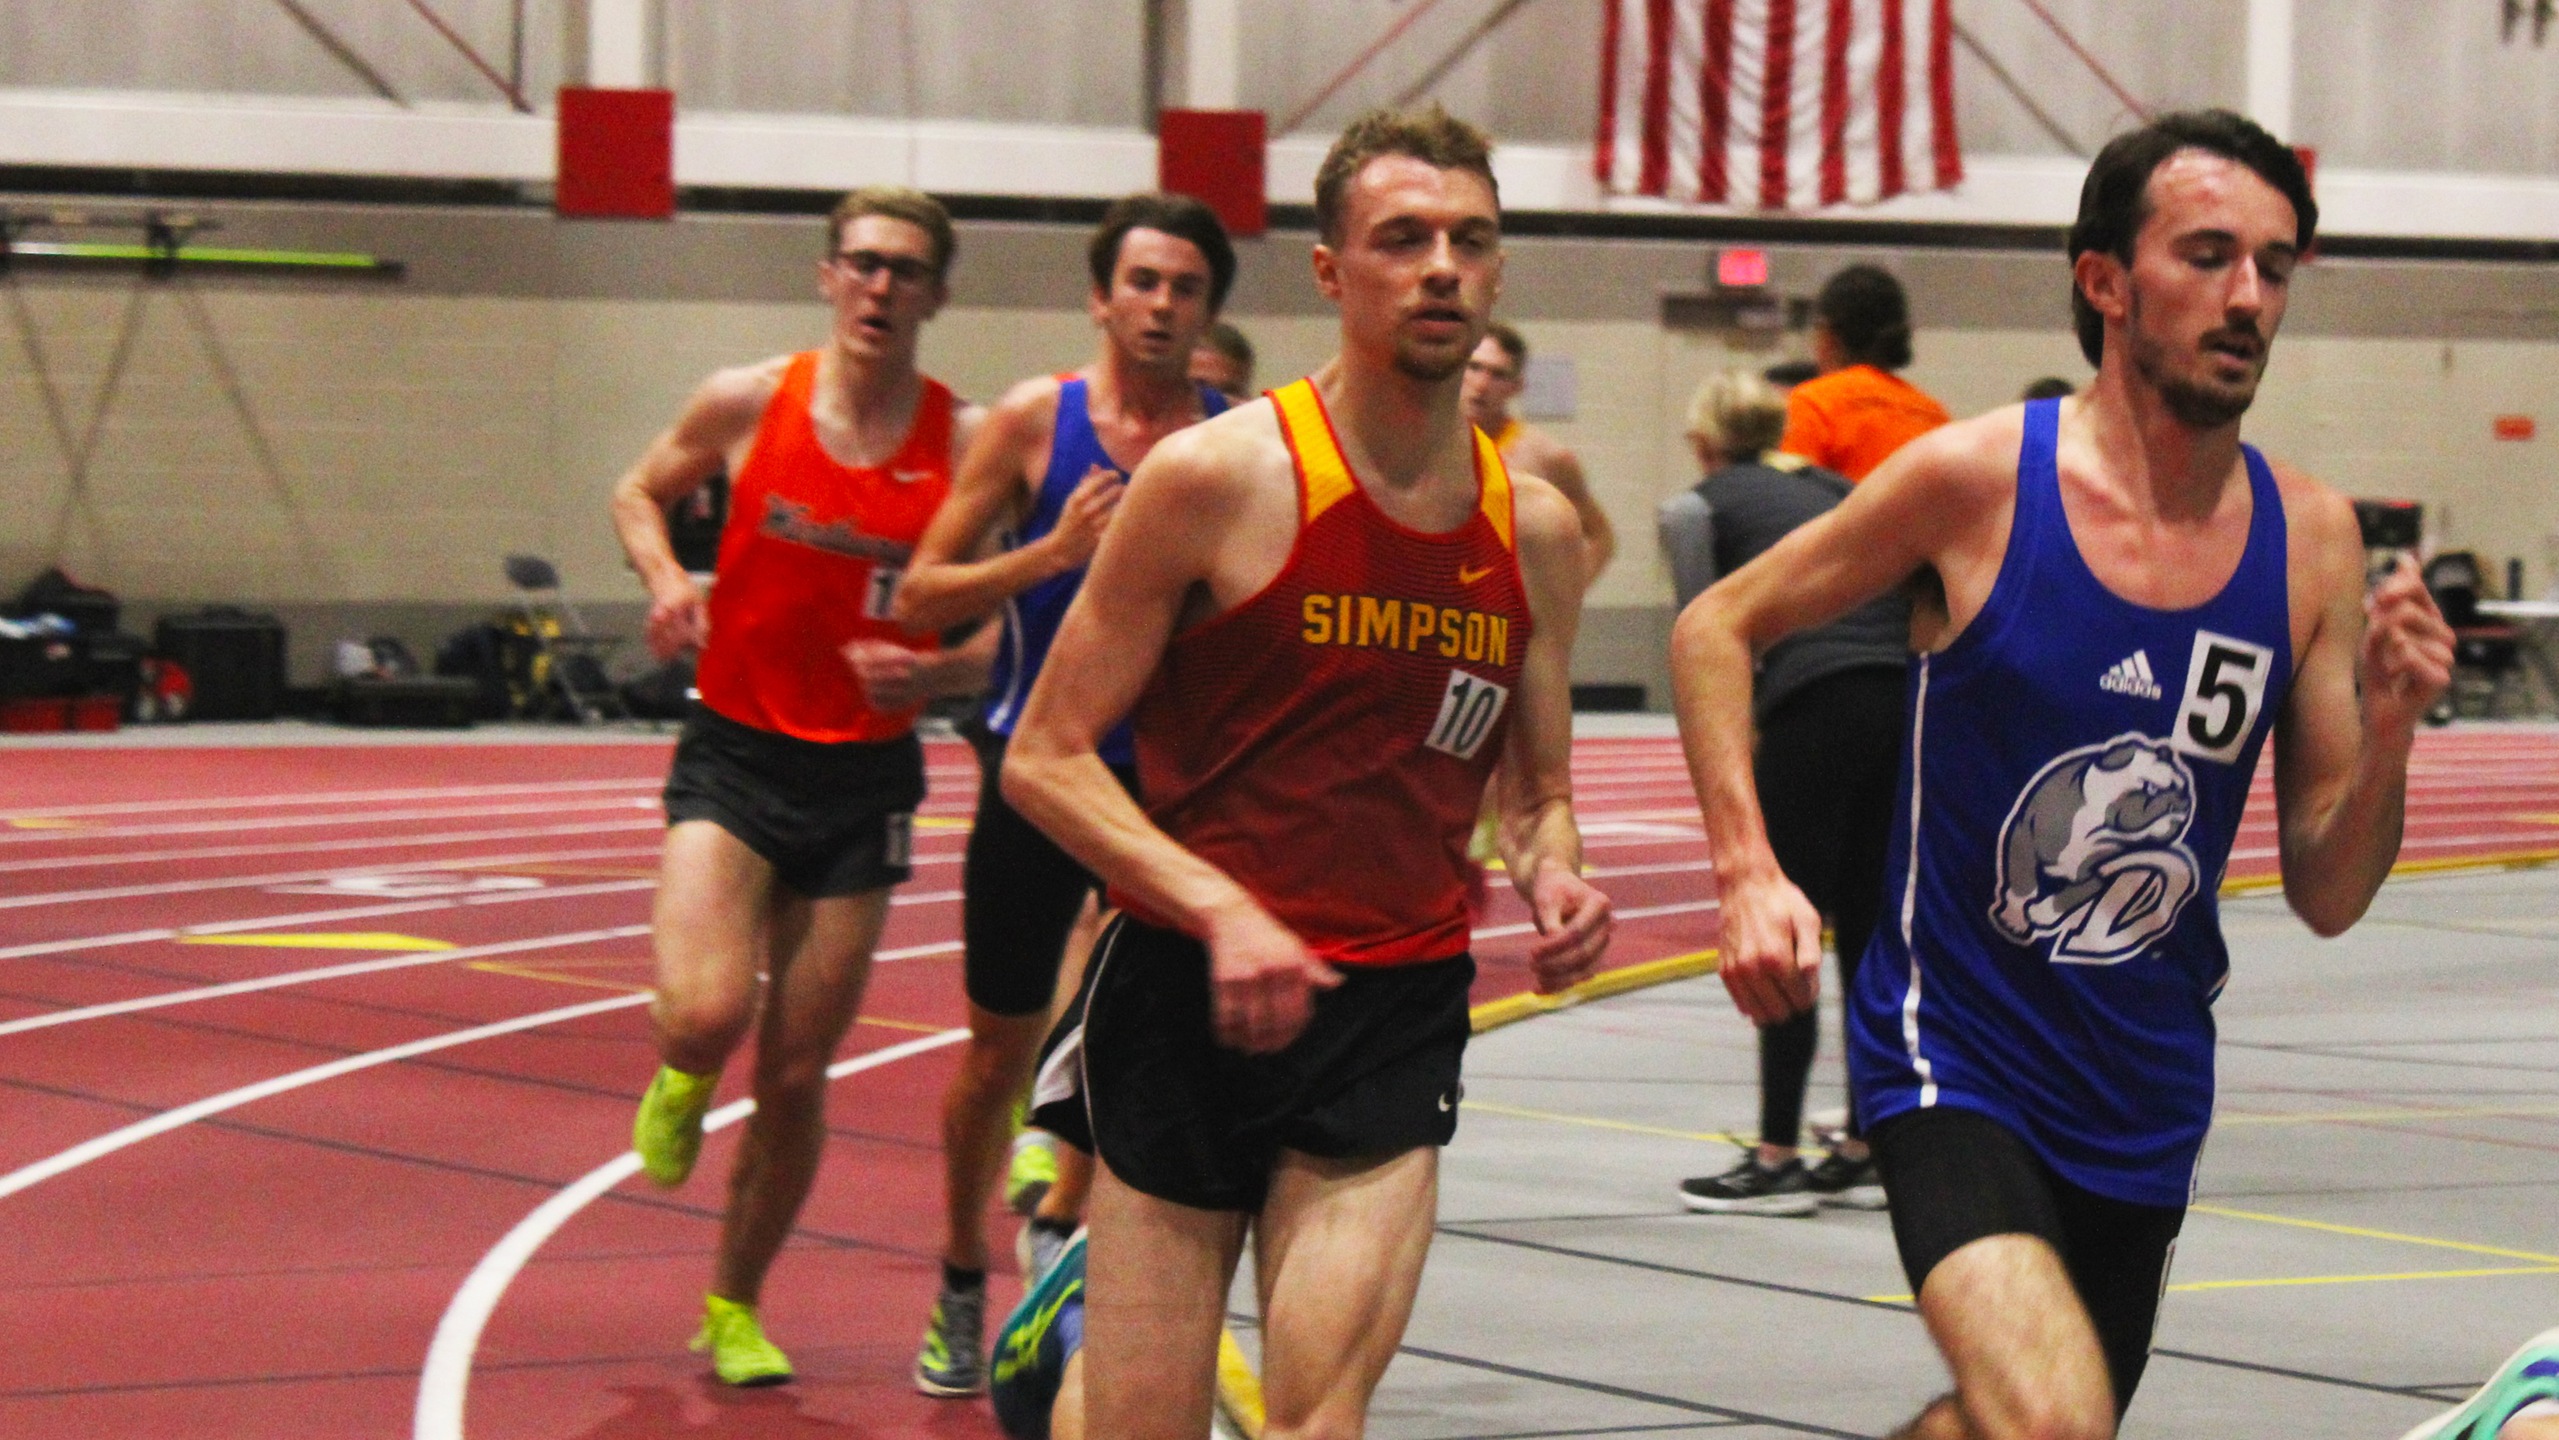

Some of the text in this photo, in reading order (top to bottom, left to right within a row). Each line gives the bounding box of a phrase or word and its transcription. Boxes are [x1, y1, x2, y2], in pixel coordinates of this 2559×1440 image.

[1302, 594, 1509, 667] SIMPSON
[1437, 677, 1497, 753] 10
[2100, 673, 2162, 700] adidas
[2187, 643, 2257, 748] 5
